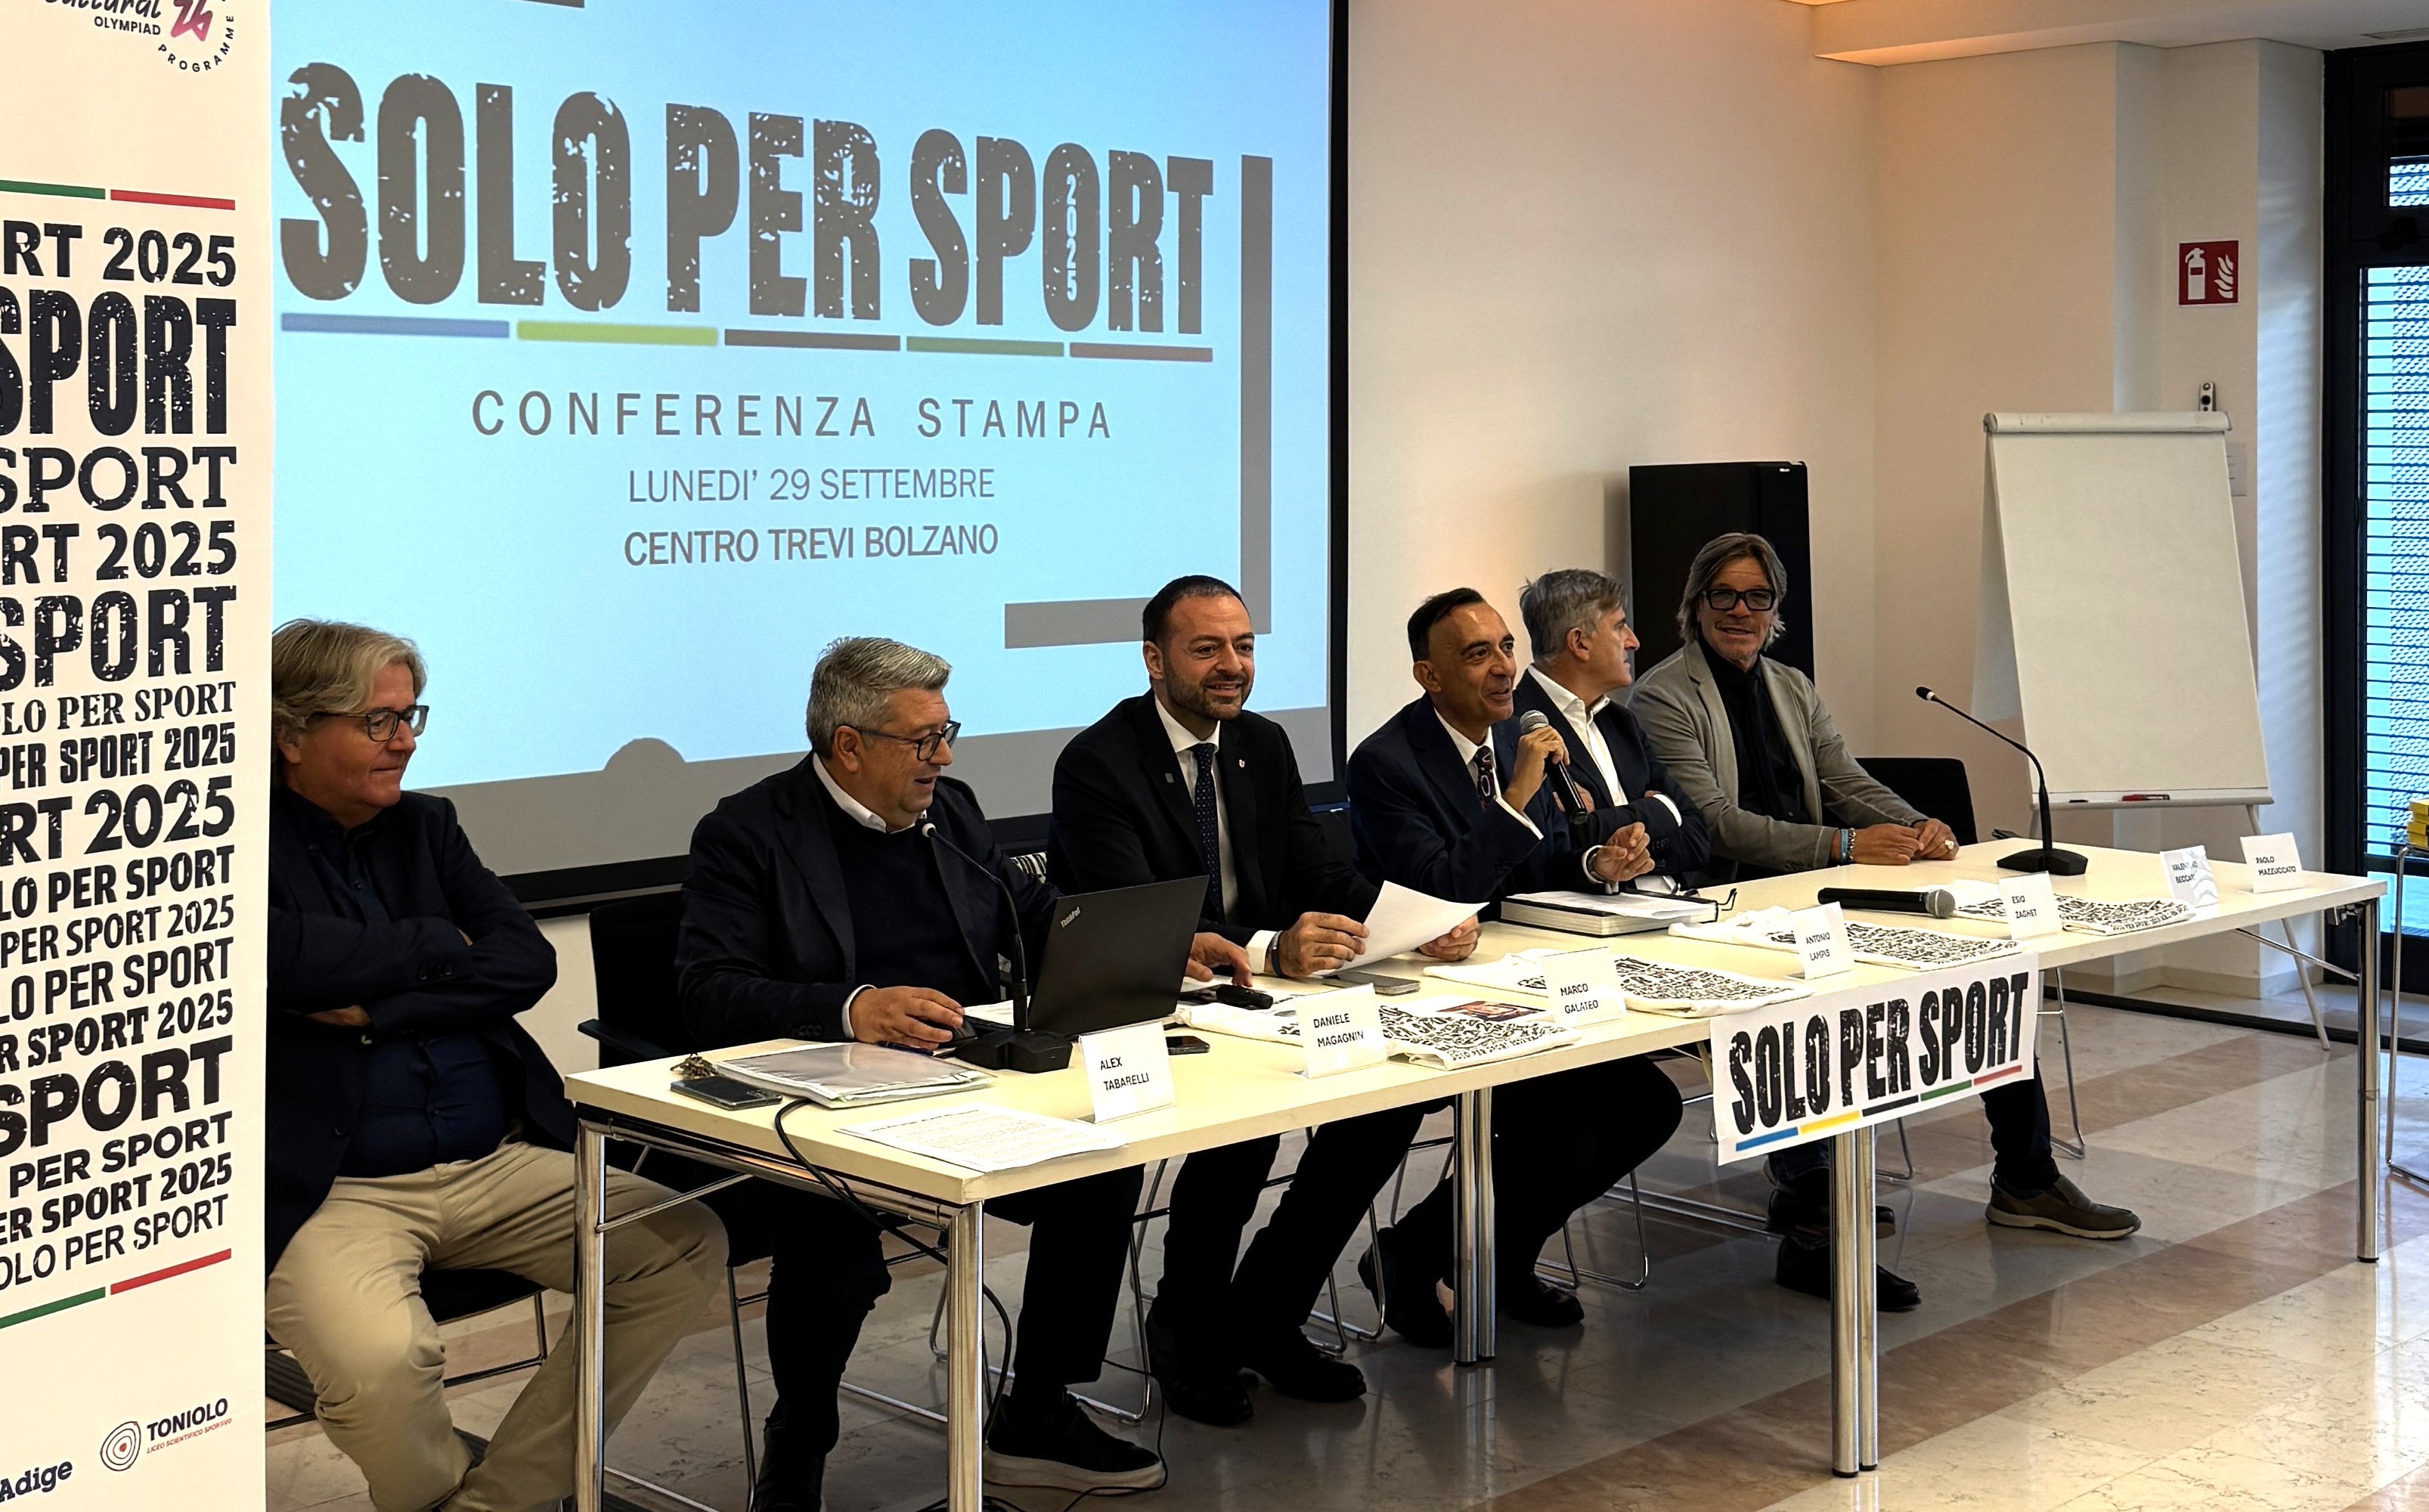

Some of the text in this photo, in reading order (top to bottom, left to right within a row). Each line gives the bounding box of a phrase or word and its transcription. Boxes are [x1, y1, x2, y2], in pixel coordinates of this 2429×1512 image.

[94, 16, 161, 36] OLYMPIAD
[157, 15, 234, 73] PROGRAMME
[280, 62, 1214, 334] SOLO PER SPORT
[103, 227, 236, 287] 2025
[1066, 174, 1077, 301] 2025
[472, 389, 1111, 438] CONFERENZA STAMPA
[770, 468, 810, 501] 29
[820, 467, 996, 500] SETTEMBRE
[96, 520, 237, 581] 2025
[624, 523, 999, 566] CENTRO TREVI BOLZANO
[0, 585, 237, 692] SPORT
[57, 692, 125, 730] PER
[135, 681, 236, 722] SPORT
[0, 722, 235, 790] PER SPORT 2025
[84, 775, 235, 855] 2025
[48, 865, 117, 913] PER
[125, 844, 234, 900] SPORT
[1, 894, 234, 968] PER SPORT 2025
[45, 961, 114, 1015] PER
[123, 937, 234, 998] SPORT
[1560, 983, 1588, 996] MARCO
[28, 1006, 149, 1069] SPORT
[157, 988, 233, 1040] 2025
[1313, 1013, 1350, 1028] DANIELE
[1565, 999, 1599, 1014] GALATEO
[1101, 1056, 1123, 1070] ALEX
[1317, 1030, 1364, 1048] MAGAGNIN
[1729, 1014, 1830, 1135] SOLO
[1840, 998, 1911, 1107] PER
[1919, 972, 2029, 1086] SPORT
[0, 1034, 233, 1157] SPORT
[1103, 1072, 1149, 1091] TABARELLI
[10, 1111, 233, 1198] PER SPORT
[42, 1173, 152, 1233] SPORT
[160, 1151, 232, 1201] 2025
[66, 1225, 125, 1271] PER
[134, 1194, 228, 1250] SPORT
[147, 1398, 228, 1441] TONIOLO
[147, 1442, 166, 1454] LICEO
[0, 1461, 73, 1503] Adige
